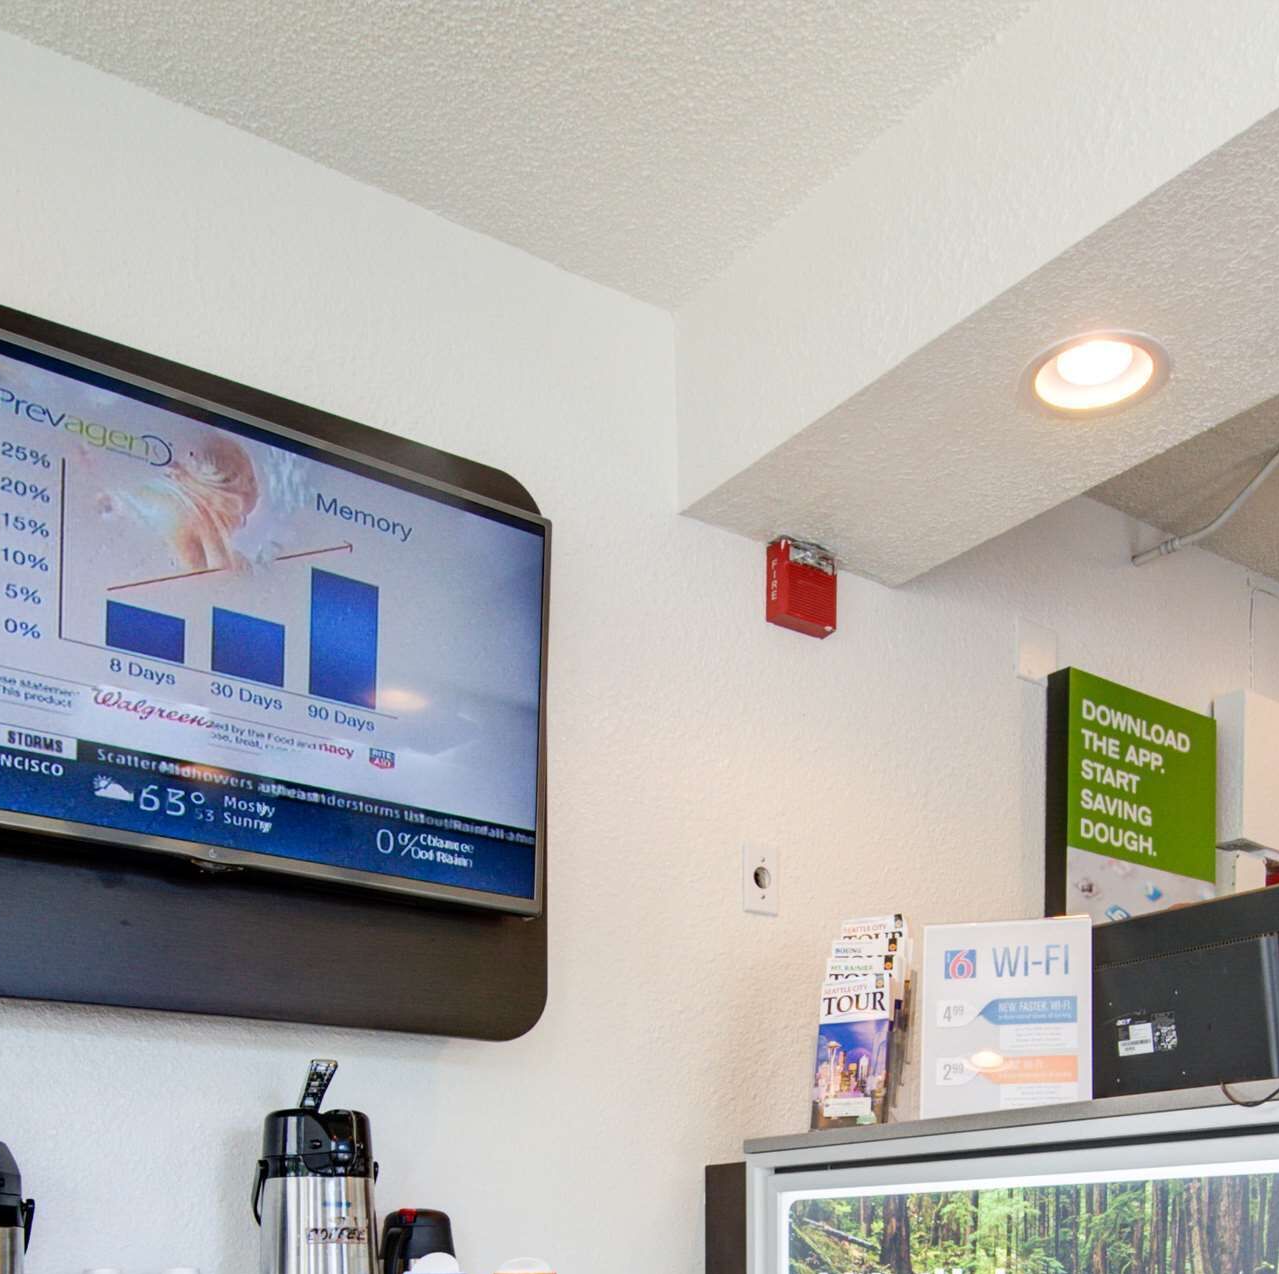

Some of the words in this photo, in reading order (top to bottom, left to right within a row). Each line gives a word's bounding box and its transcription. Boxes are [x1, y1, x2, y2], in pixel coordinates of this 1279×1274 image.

[1, 441, 51, 469] 25%
[0, 476, 51, 504] 20%
[1, 512, 50, 538] 15%
[316, 492, 414, 543] Memory
[1, 547, 49, 572] 10%
[5, 583, 42, 605] 5%
[4, 617, 41, 640] 0%
[109, 657, 122, 674] 8
[128, 660, 177, 687] Days
[210, 681, 233, 699] 30
[239, 686, 284, 712] Days
[307, 704, 330, 721] 90
[334, 708, 376, 733] Days
[1081, 698, 1191, 753] DOWNLOAD
[1081, 728, 1120, 760] THE
[1124, 744, 1166, 775] APP.
[1081, 758, 1141, 794] START
[1080, 788, 1153, 827] SAVING
[1080, 817, 1158, 858] DOUGH.
[991, 943, 1070, 978] WI-FI
[823, 990, 887, 1017] TOUR
